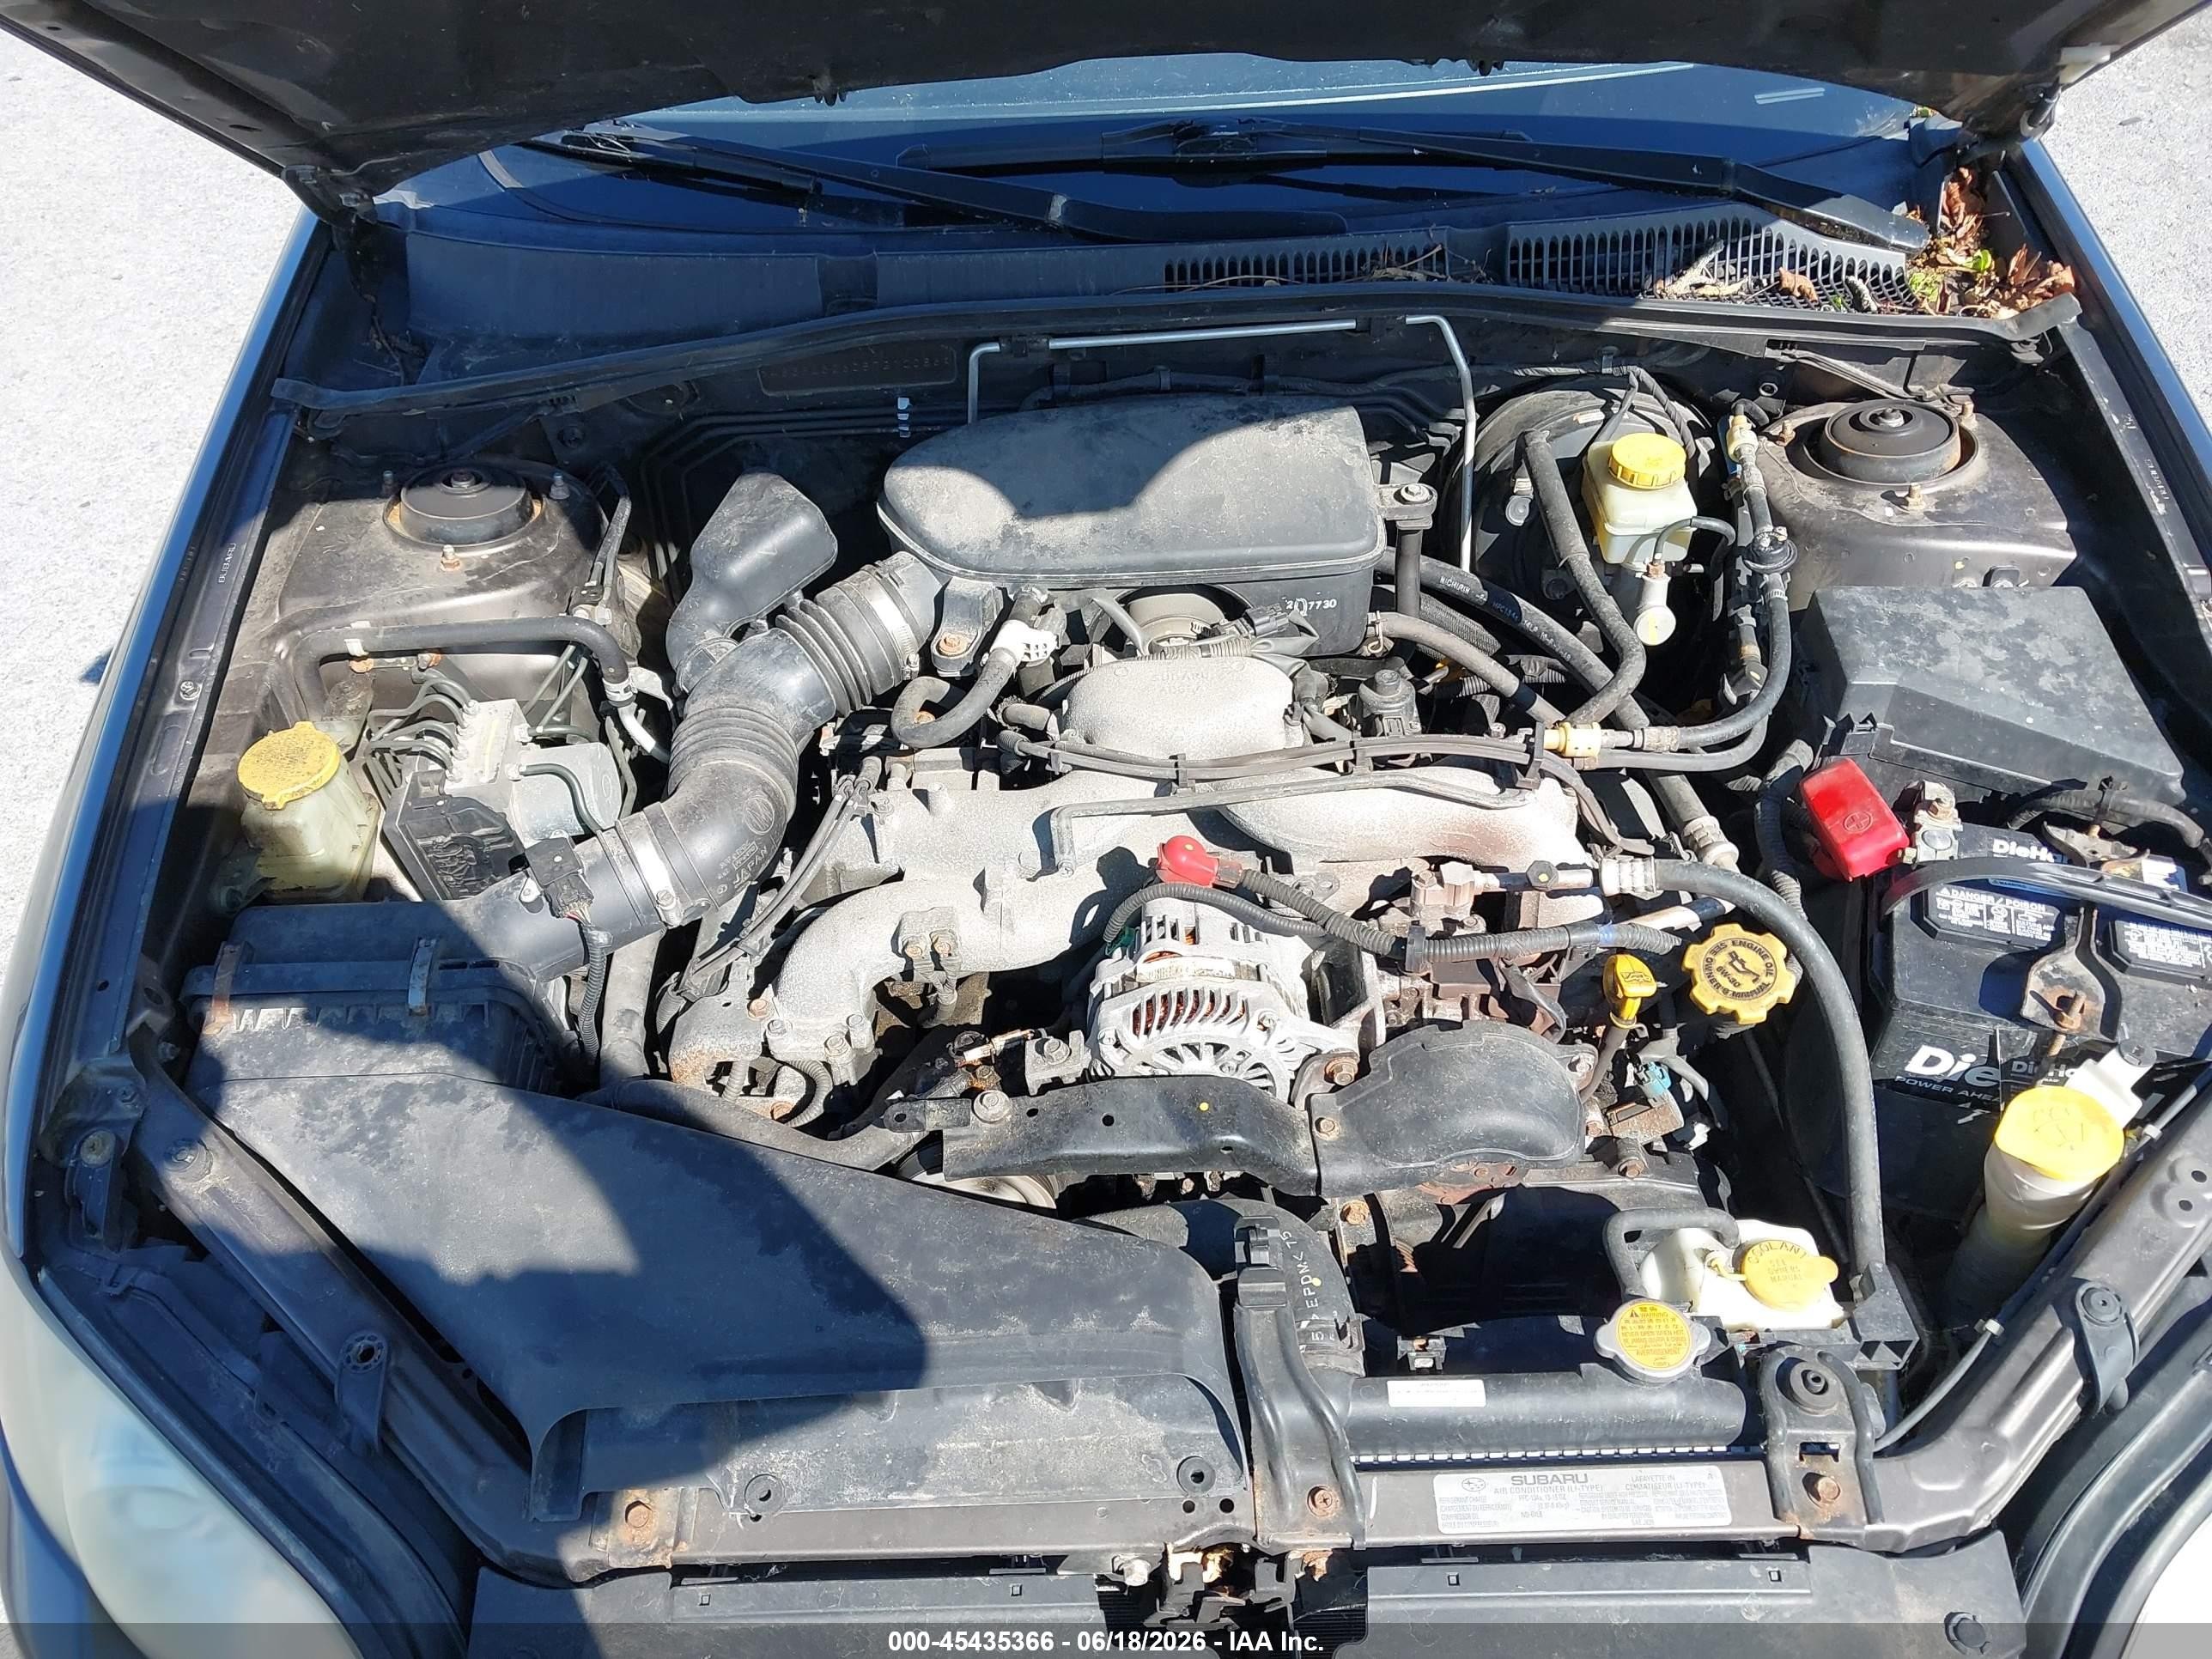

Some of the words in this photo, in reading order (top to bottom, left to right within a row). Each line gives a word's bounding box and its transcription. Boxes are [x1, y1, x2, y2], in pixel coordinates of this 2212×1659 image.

[218, 543, 237, 584] SUBARU
[732, 845, 769, 885] JAPAN
[1951, 888, 1996, 905] DANGER
[2005, 898, 2046, 912] POISON
[1710, 942, 1728, 956] SEE
[1731, 939, 1770, 962] ENGINE
[1765, 962, 1775, 977] OIL
[1704, 957, 1730, 996] OWNER'S
[1729, 981, 1771, 998] MANUAL
[1894, 1075, 1954, 1094] POWER
[1747, 1242, 1808, 1264] COOLANT
[1510, 1485, 1565, 1494] CONDITIONER
[1511, 1473, 1589, 1486] SUBARU
